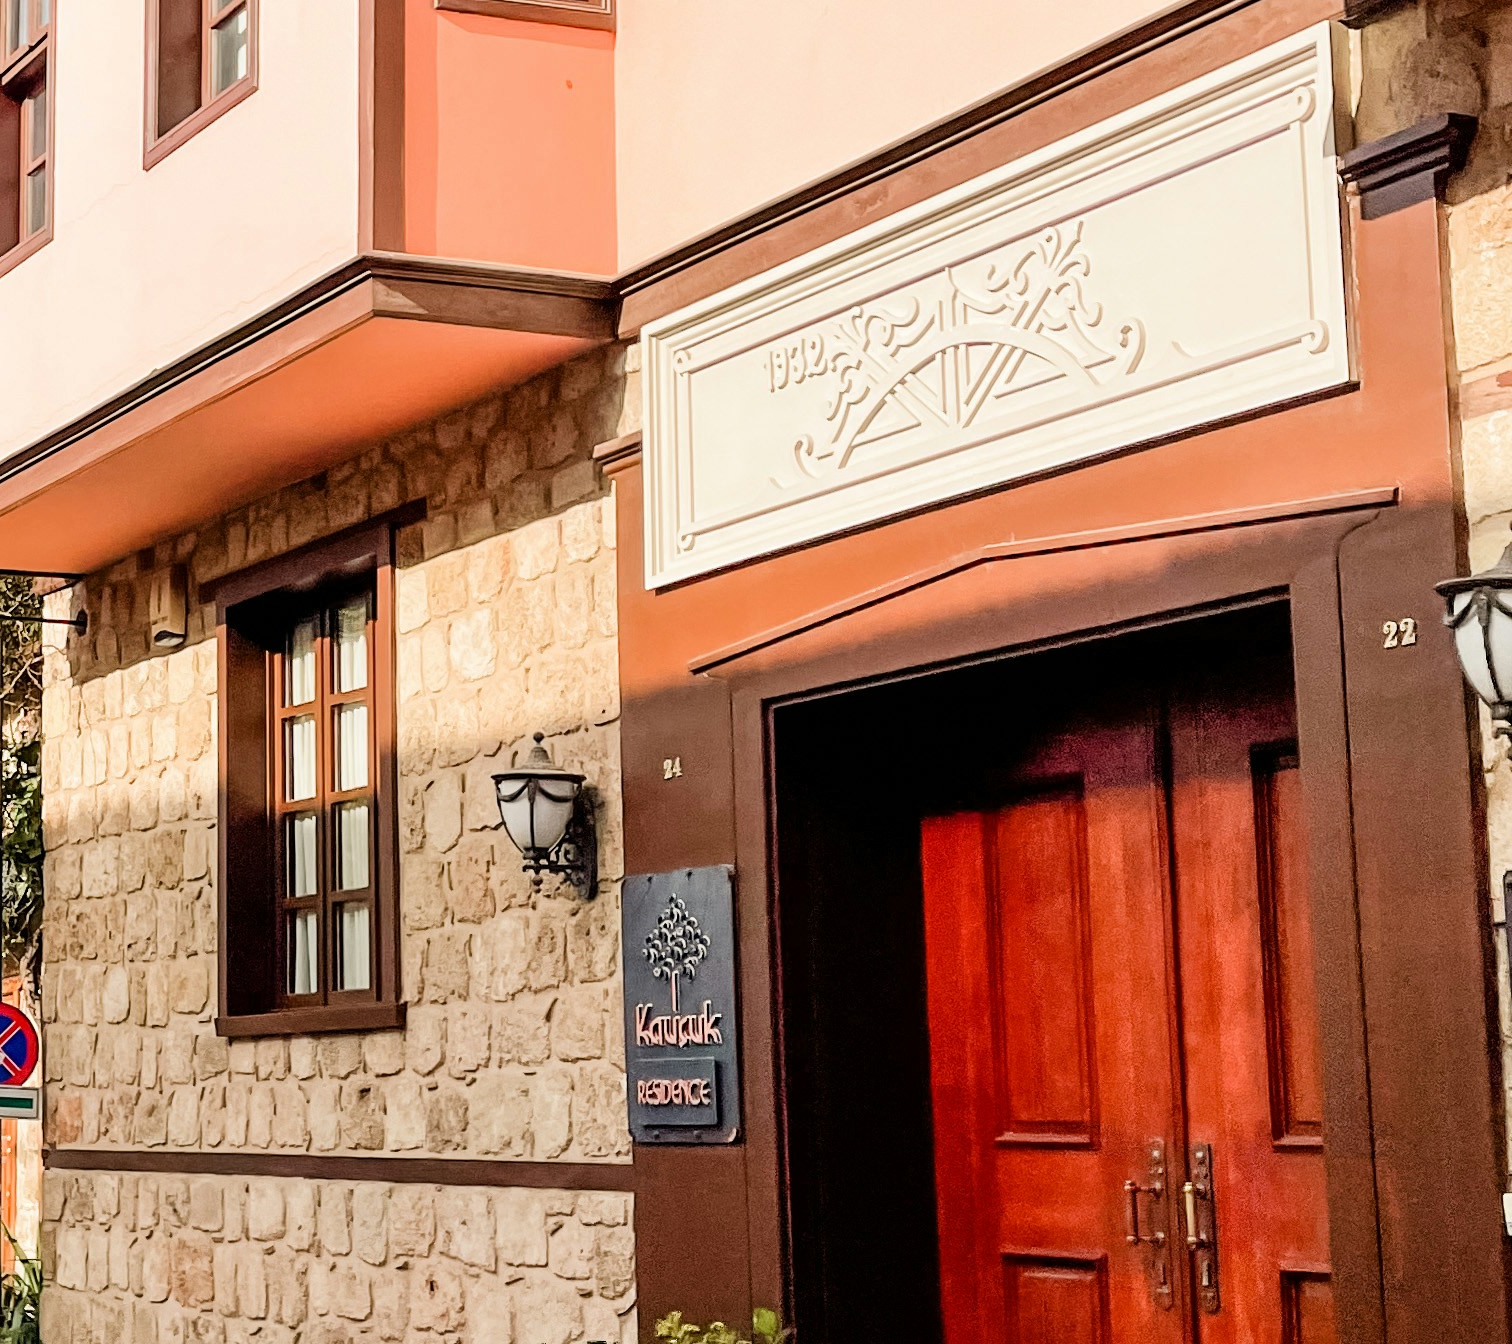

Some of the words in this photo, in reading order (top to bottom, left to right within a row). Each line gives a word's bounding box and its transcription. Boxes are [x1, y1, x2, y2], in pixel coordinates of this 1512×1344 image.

[763, 332, 828, 393] 1932
[1383, 617, 1417, 649] 22
[663, 756, 683, 780] 24
[636, 1078, 712, 1106] RESIDENCE
